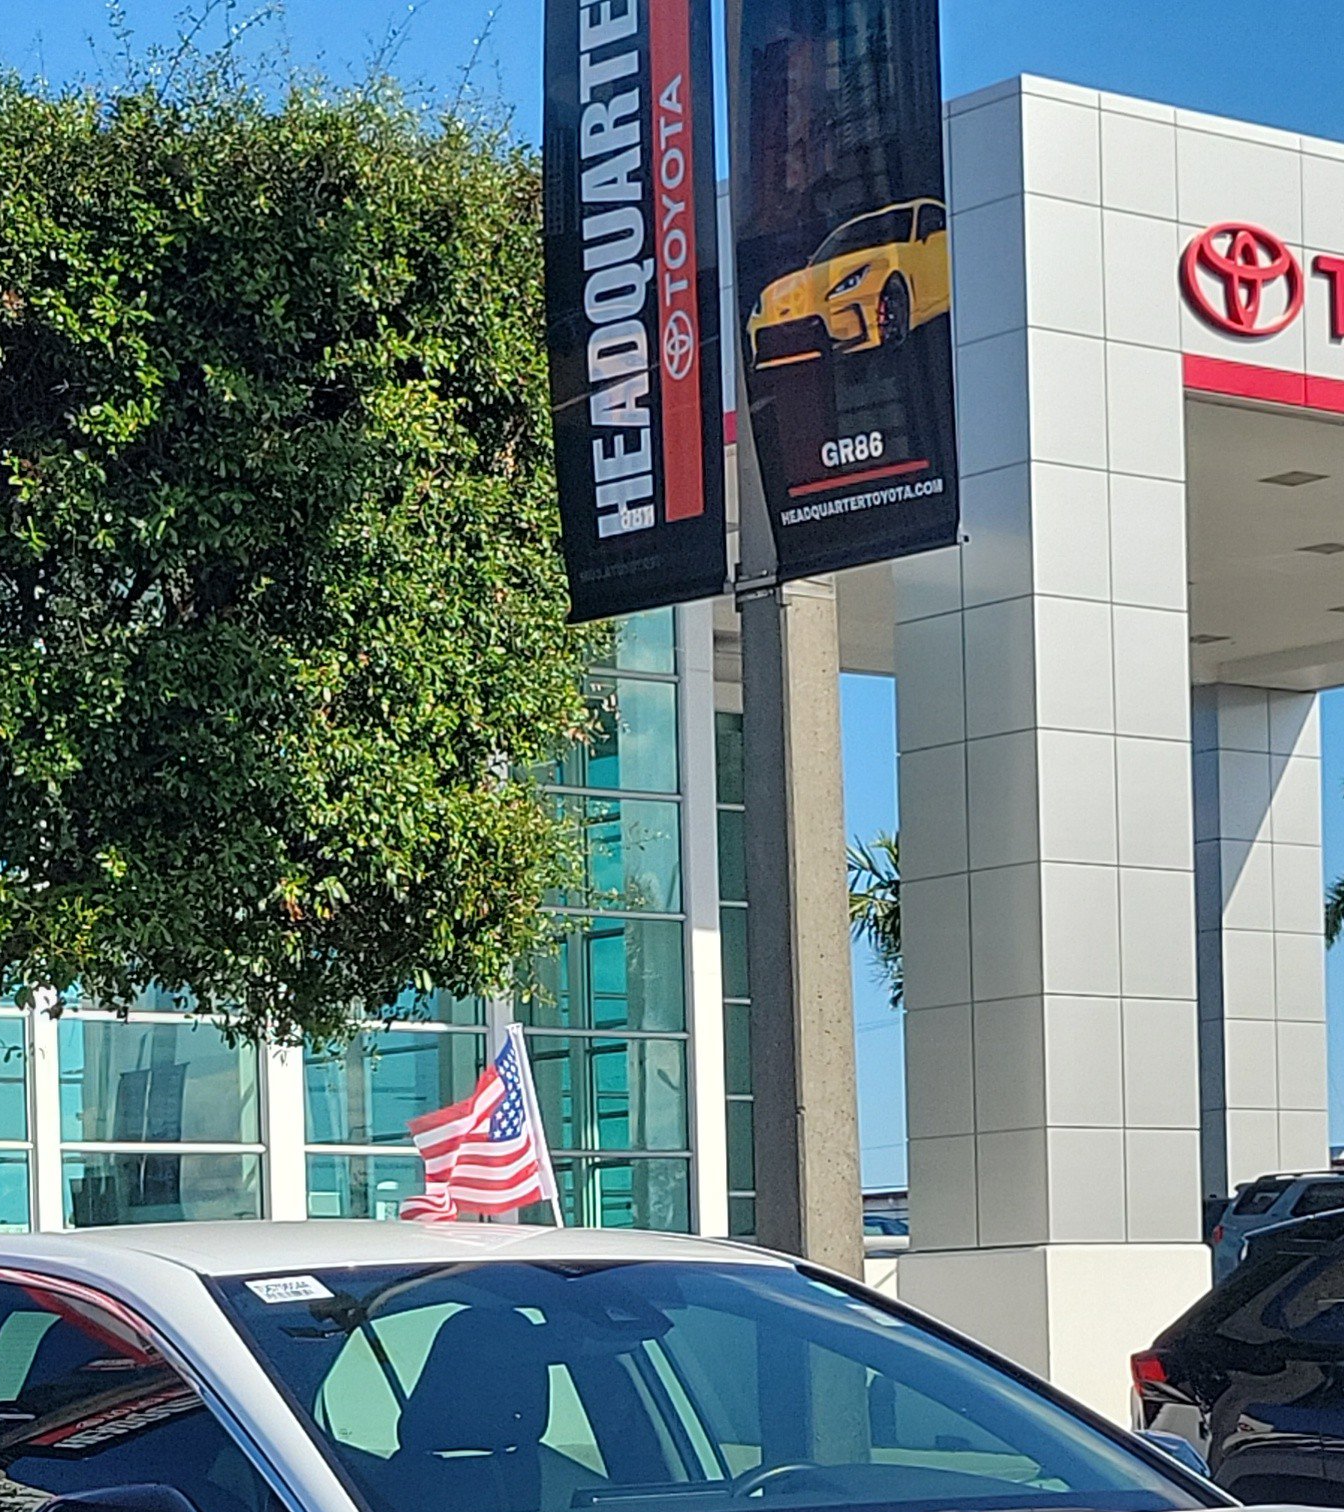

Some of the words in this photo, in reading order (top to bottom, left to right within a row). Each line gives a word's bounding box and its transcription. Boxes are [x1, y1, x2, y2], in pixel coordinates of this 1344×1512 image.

[659, 74, 690, 306] TOYOTA
[579, 0, 654, 538] HEADQUARTE
[781, 478, 943, 526] HEADQUARTERTOYOTA.COM
[821, 431, 884, 467] GR86
